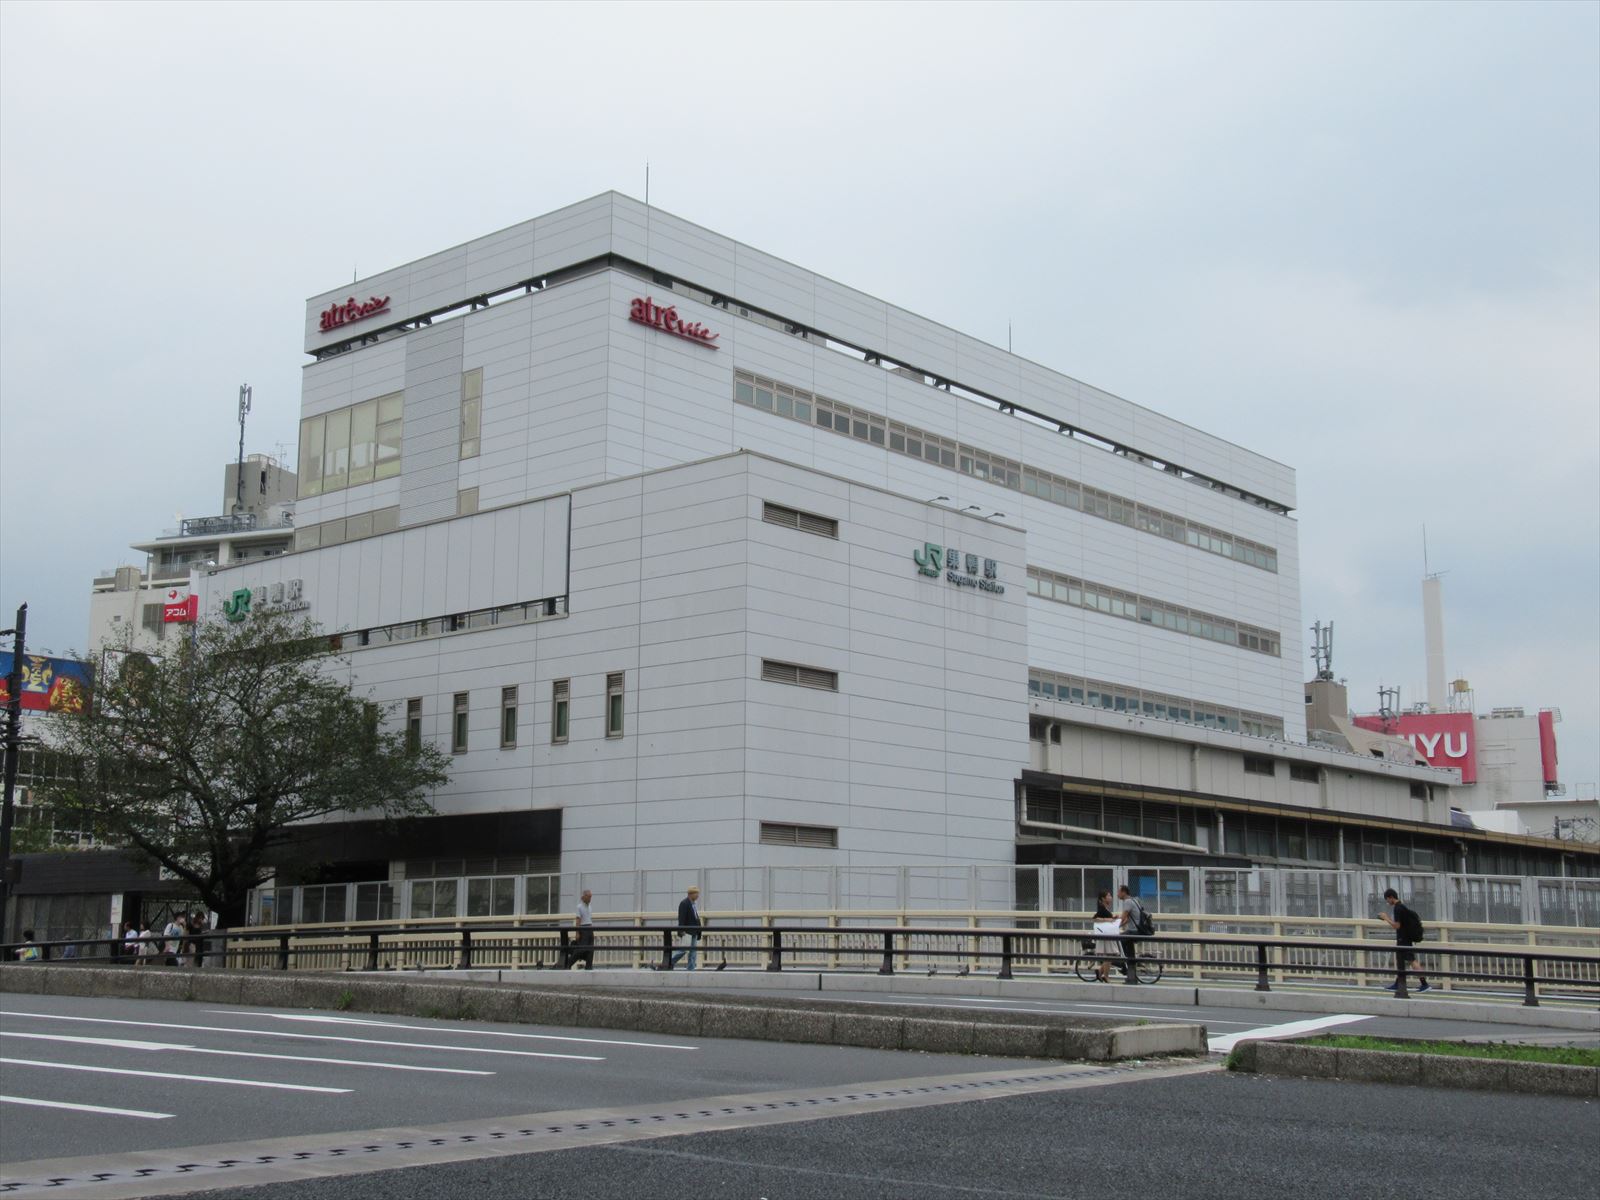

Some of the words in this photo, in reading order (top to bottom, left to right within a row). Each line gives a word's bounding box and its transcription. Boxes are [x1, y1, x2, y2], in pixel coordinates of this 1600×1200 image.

[914, 542, 943, 571] JR
[165, 608, 187, 617] アコム
[223, 588, 252, 616] JR
